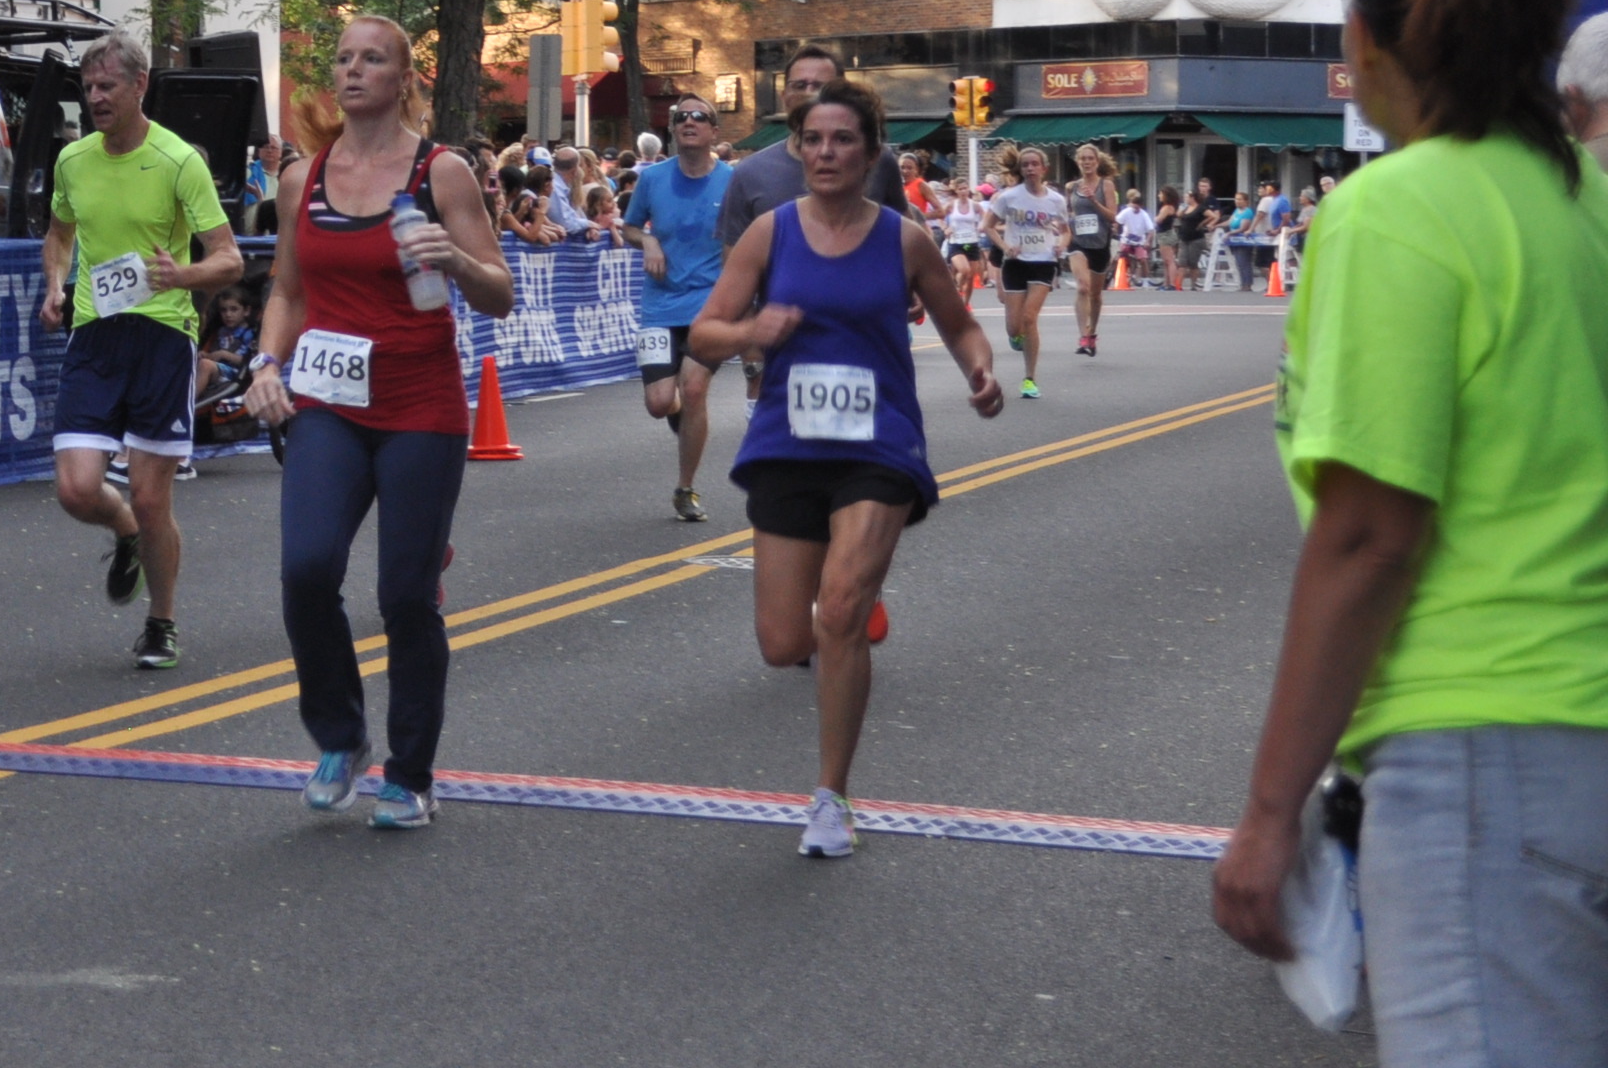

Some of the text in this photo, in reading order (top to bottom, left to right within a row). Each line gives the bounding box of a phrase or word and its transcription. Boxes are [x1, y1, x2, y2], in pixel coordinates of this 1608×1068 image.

[1047, 74, 1078, 88] SOLE
[1019, 234, 1045, 245] 1004
[96, 266, 139, 298] 529
[297, 345, 366, 382] 1468
[793, 381, 872, 415] 1905
